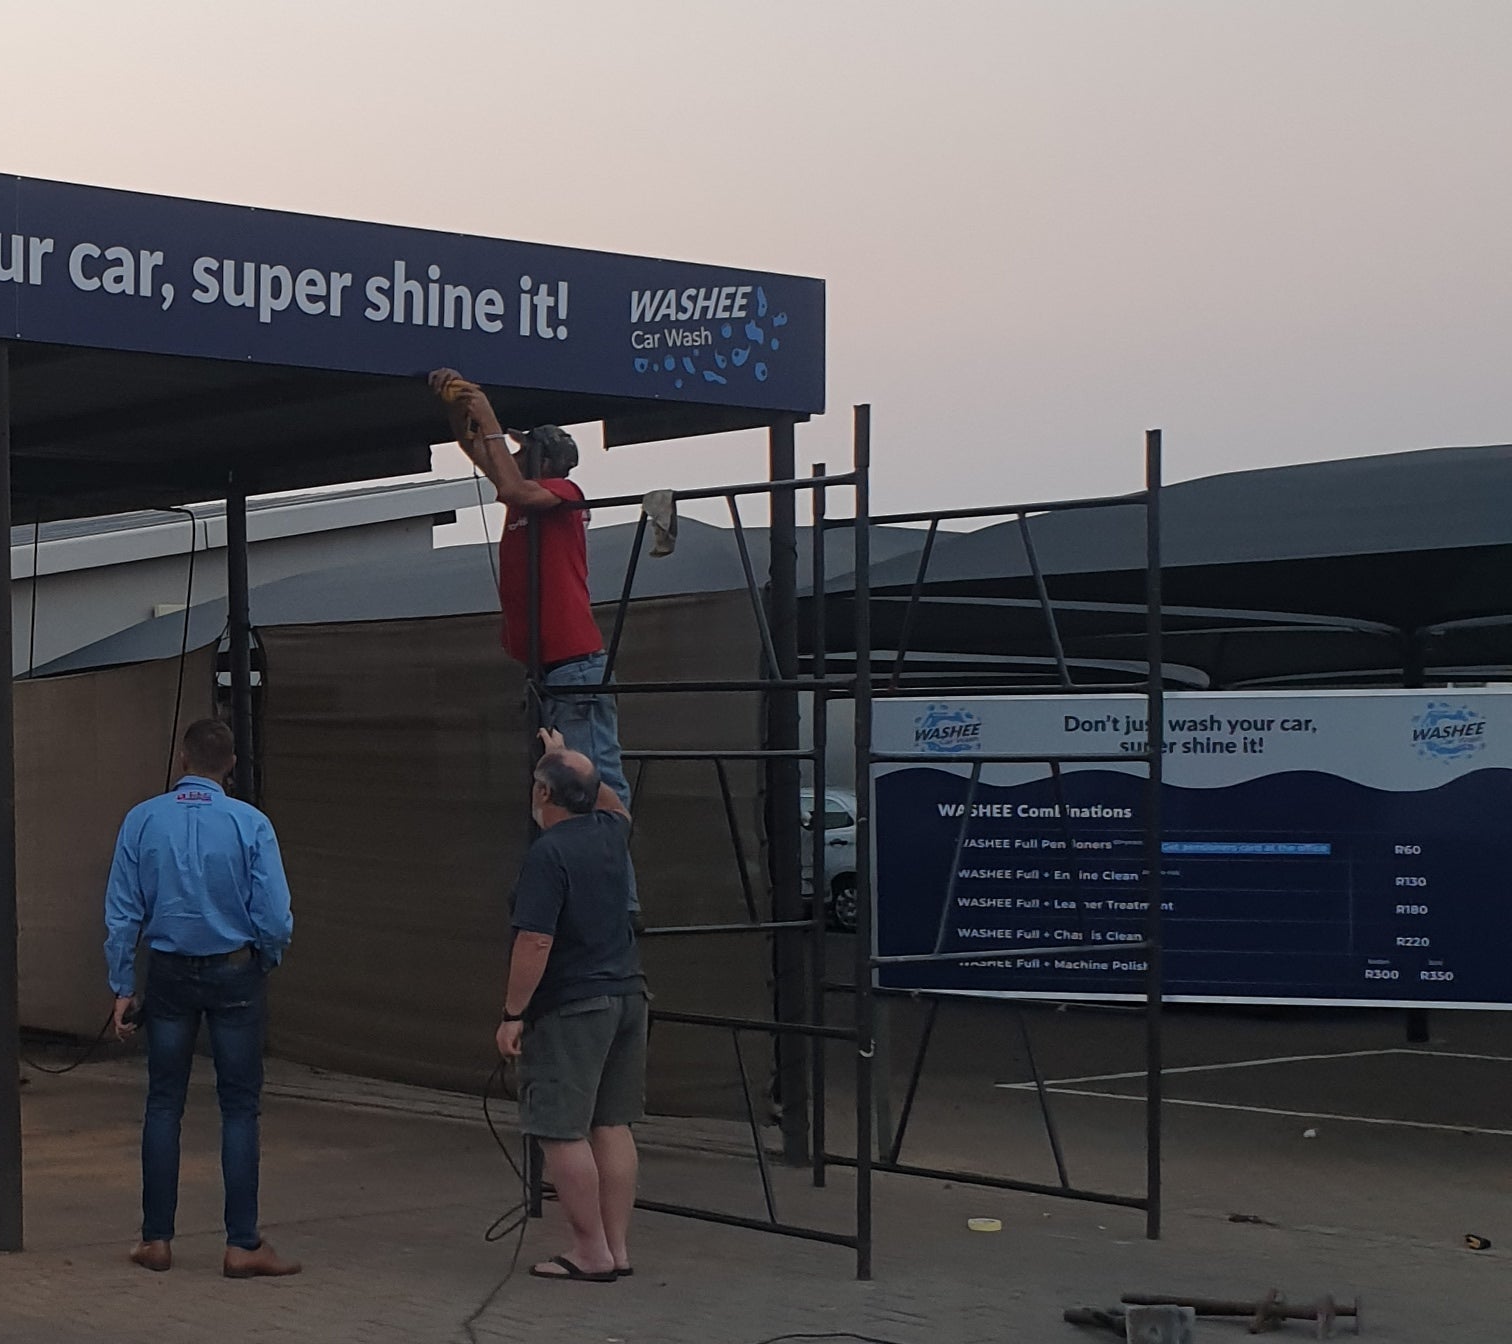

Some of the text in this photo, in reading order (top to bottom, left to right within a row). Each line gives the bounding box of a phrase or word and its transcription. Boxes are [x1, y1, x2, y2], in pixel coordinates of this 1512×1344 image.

[69, 240, 174, 311] car,
[193, 256, 352, 323] super
[365, 260, 504, 334] shine
[519, 275, 569, 341] it!
[630, 286, 752, 324] WASHEE
[631, 326, 712, 349] Car Wash
[1169, 715, 1221, 732] wash
[1227, 718, 1274, 735] your
[1280, 718, 1317, 734] car,
[915, 723, 982, 742] WASHEE
[1412, 722, 1486, 742] WASHEE
[1182, 737, 1236, 753] shine
[1242, 737, 1263, 753] it!
[1014, 838, 1038, 848] Full
[1395, 844, 1421, 855] R60
[958, 869, 1012, 879] WASHEE
[1016, 869, 1039, 879] Full
[1054, 870, 1099, 880] Enine
[1102, 871, 1139, 881] Clean
[1395, 876, 1426, 887] R130
[957, 897, 1012, 907] WASHEE
[1016, 899, 1039, 908] Full
[1396, 904, 1428, 915] R180
[957, 928, 1012, 938] WASHEE
[1016, 929, 1039, 939] Full
[1106, 931, 1142, 941] Clean
[1396, 936, 1429, 947] R220
[1016, 959, 1039, 968] Full
[1054, 960, 1109, 970] Machine
[1364, 969, 1399, 980] R300
